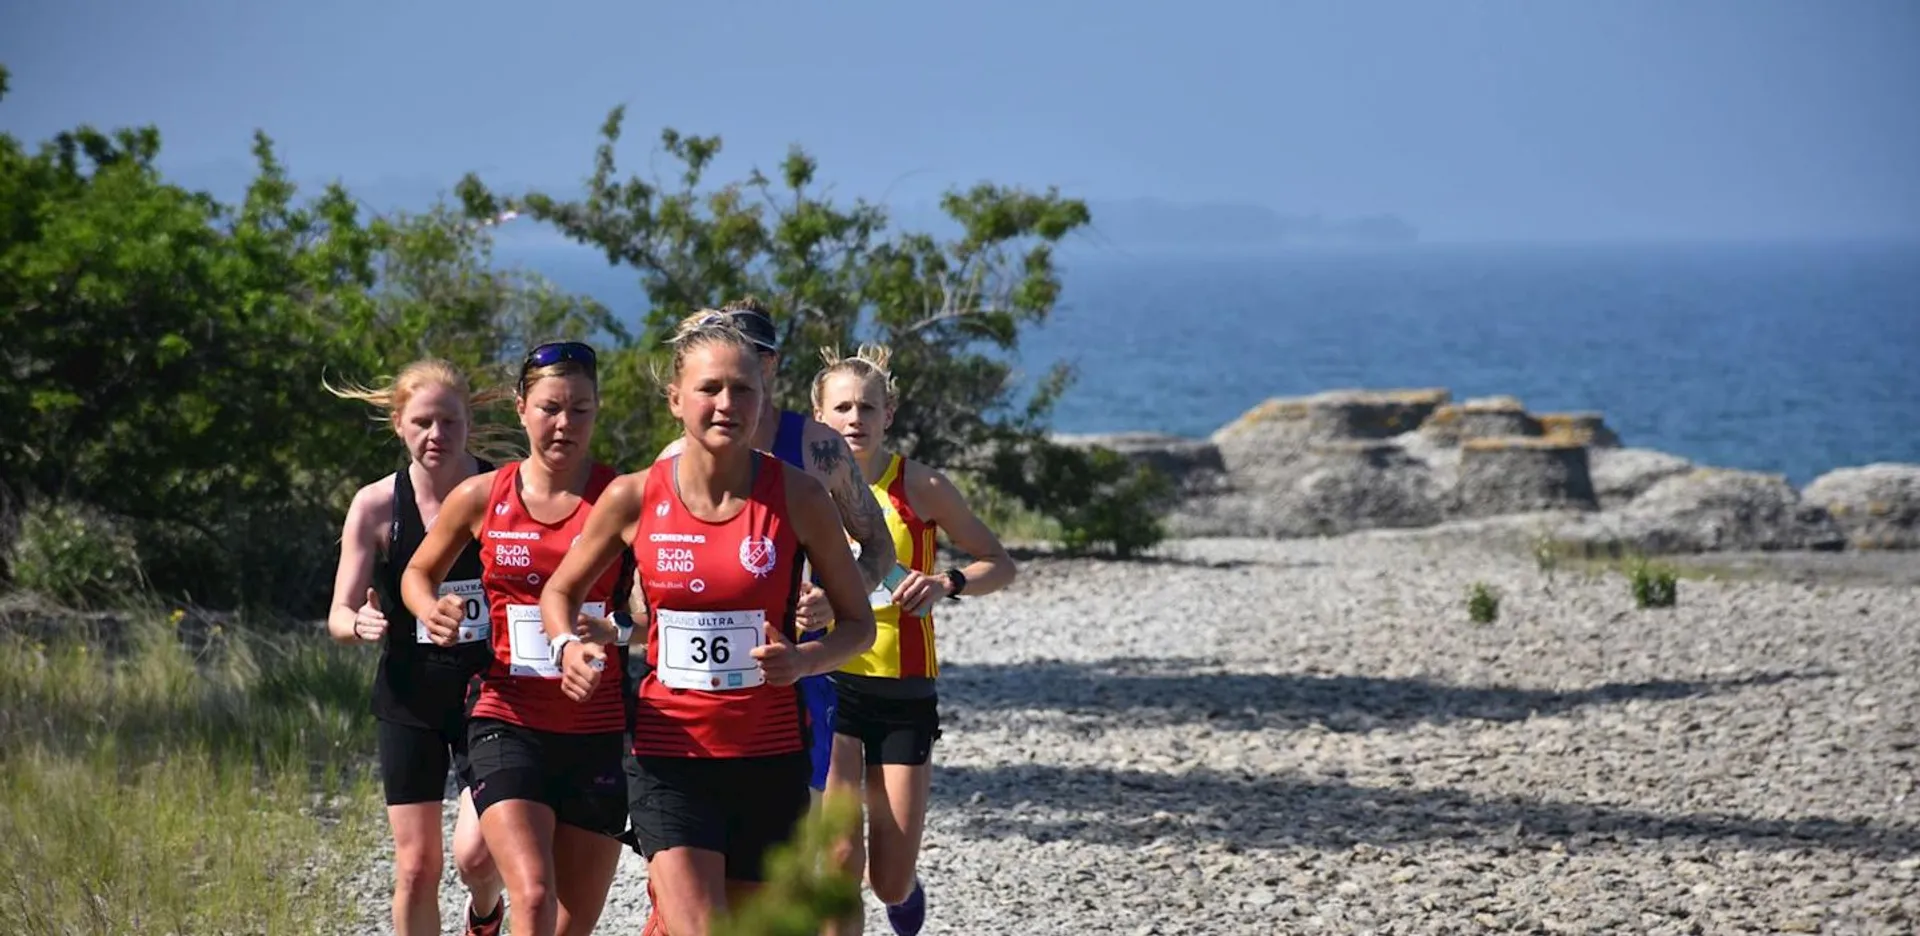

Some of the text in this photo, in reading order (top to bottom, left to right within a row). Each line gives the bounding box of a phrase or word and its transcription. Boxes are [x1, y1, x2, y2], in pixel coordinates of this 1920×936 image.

[650, 534, 705, 543] COMENIUS
[496, 556, 530, 567] SAND
[656, 560, 694, 572] SAND
[466, 599, 480, 620] 0
[698, 617, 735, 626] ULTRA
[690, 635, 730, 664] 36
